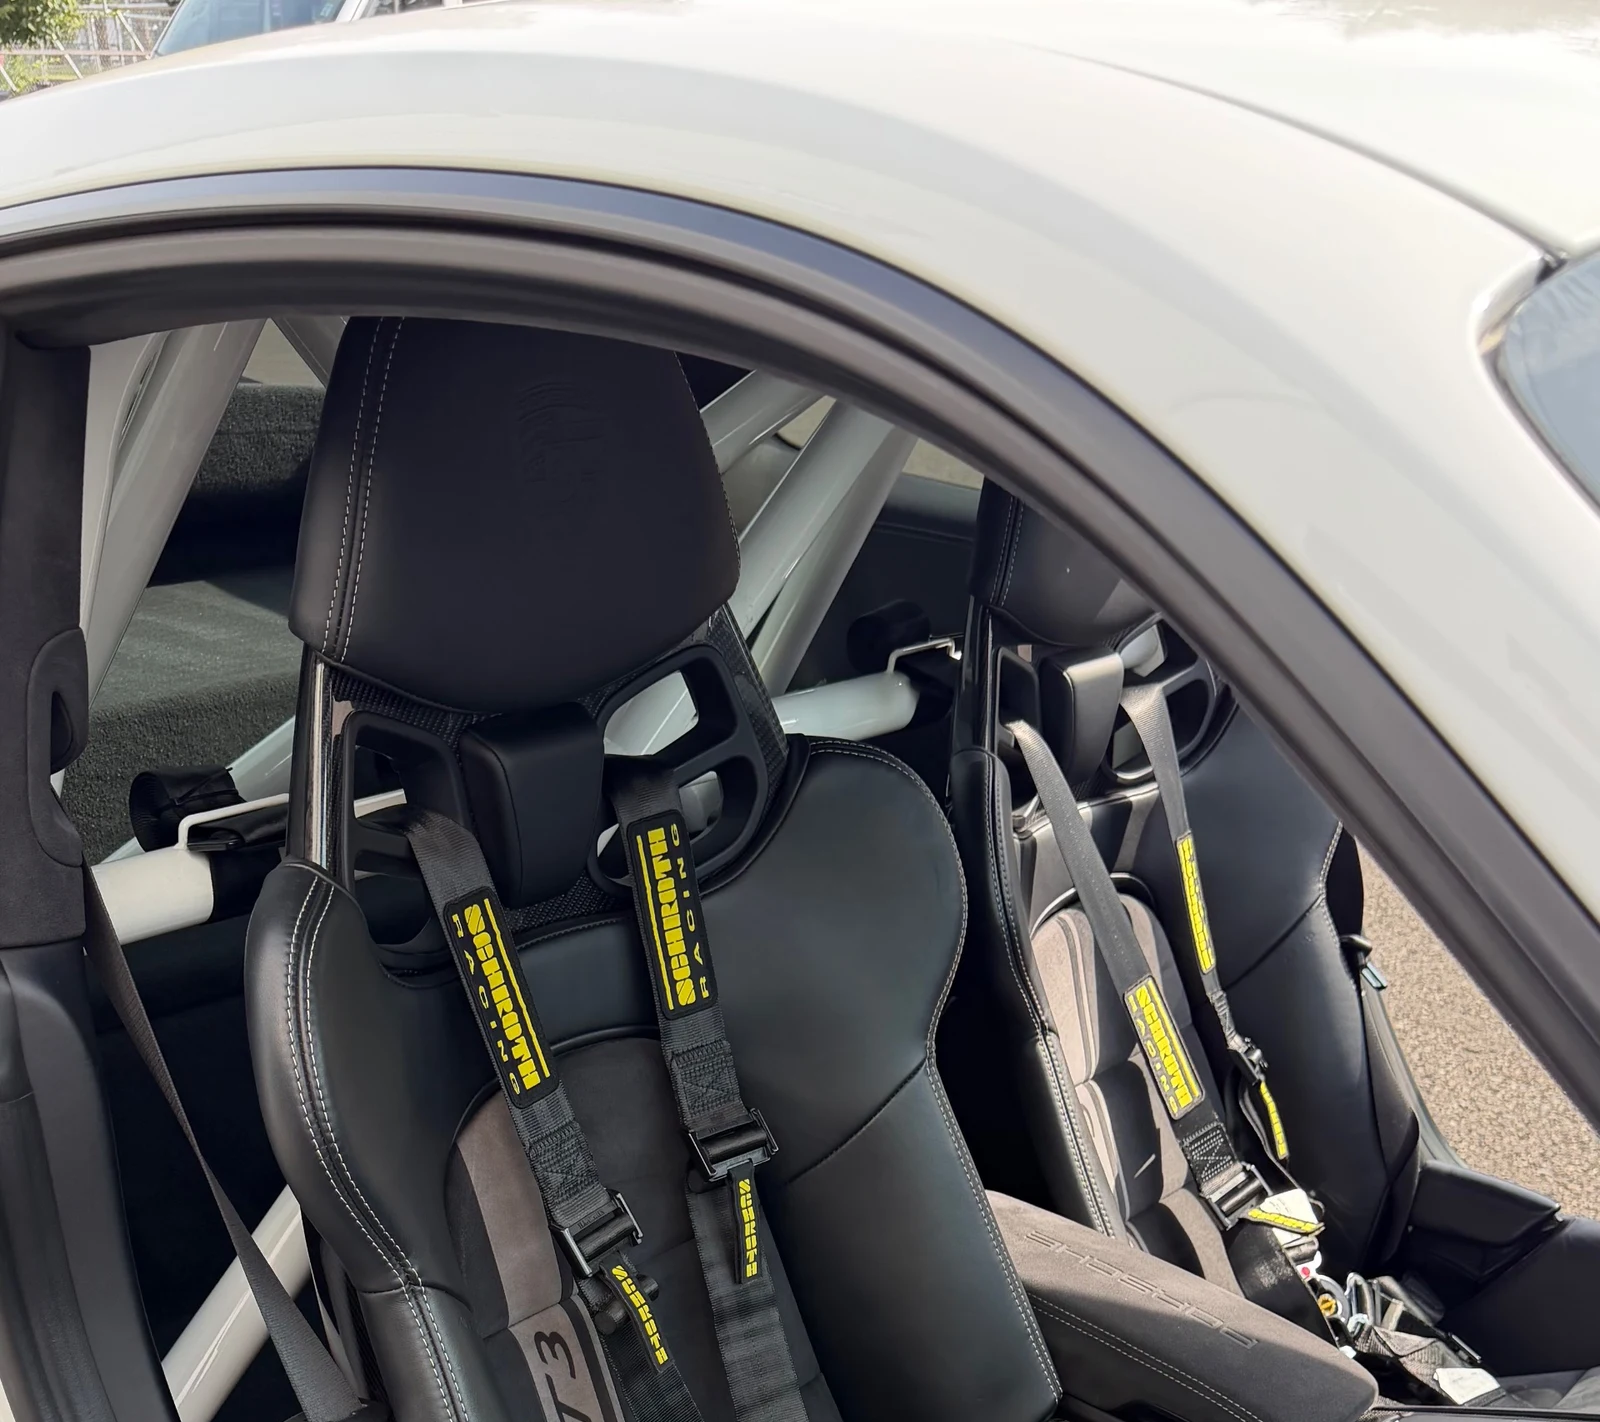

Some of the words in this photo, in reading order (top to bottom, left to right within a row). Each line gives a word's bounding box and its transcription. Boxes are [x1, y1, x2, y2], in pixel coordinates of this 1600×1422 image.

[648, 827, 697, 1006] SCHROTH
[464, 904, 541, 1090] SCHROTH
[739, 1179, 758, 1278] SCHROTH
[612, 1265, 669, 1365] SCHROTH
[1024, 1230, 1260, 1350] PORSCHE
